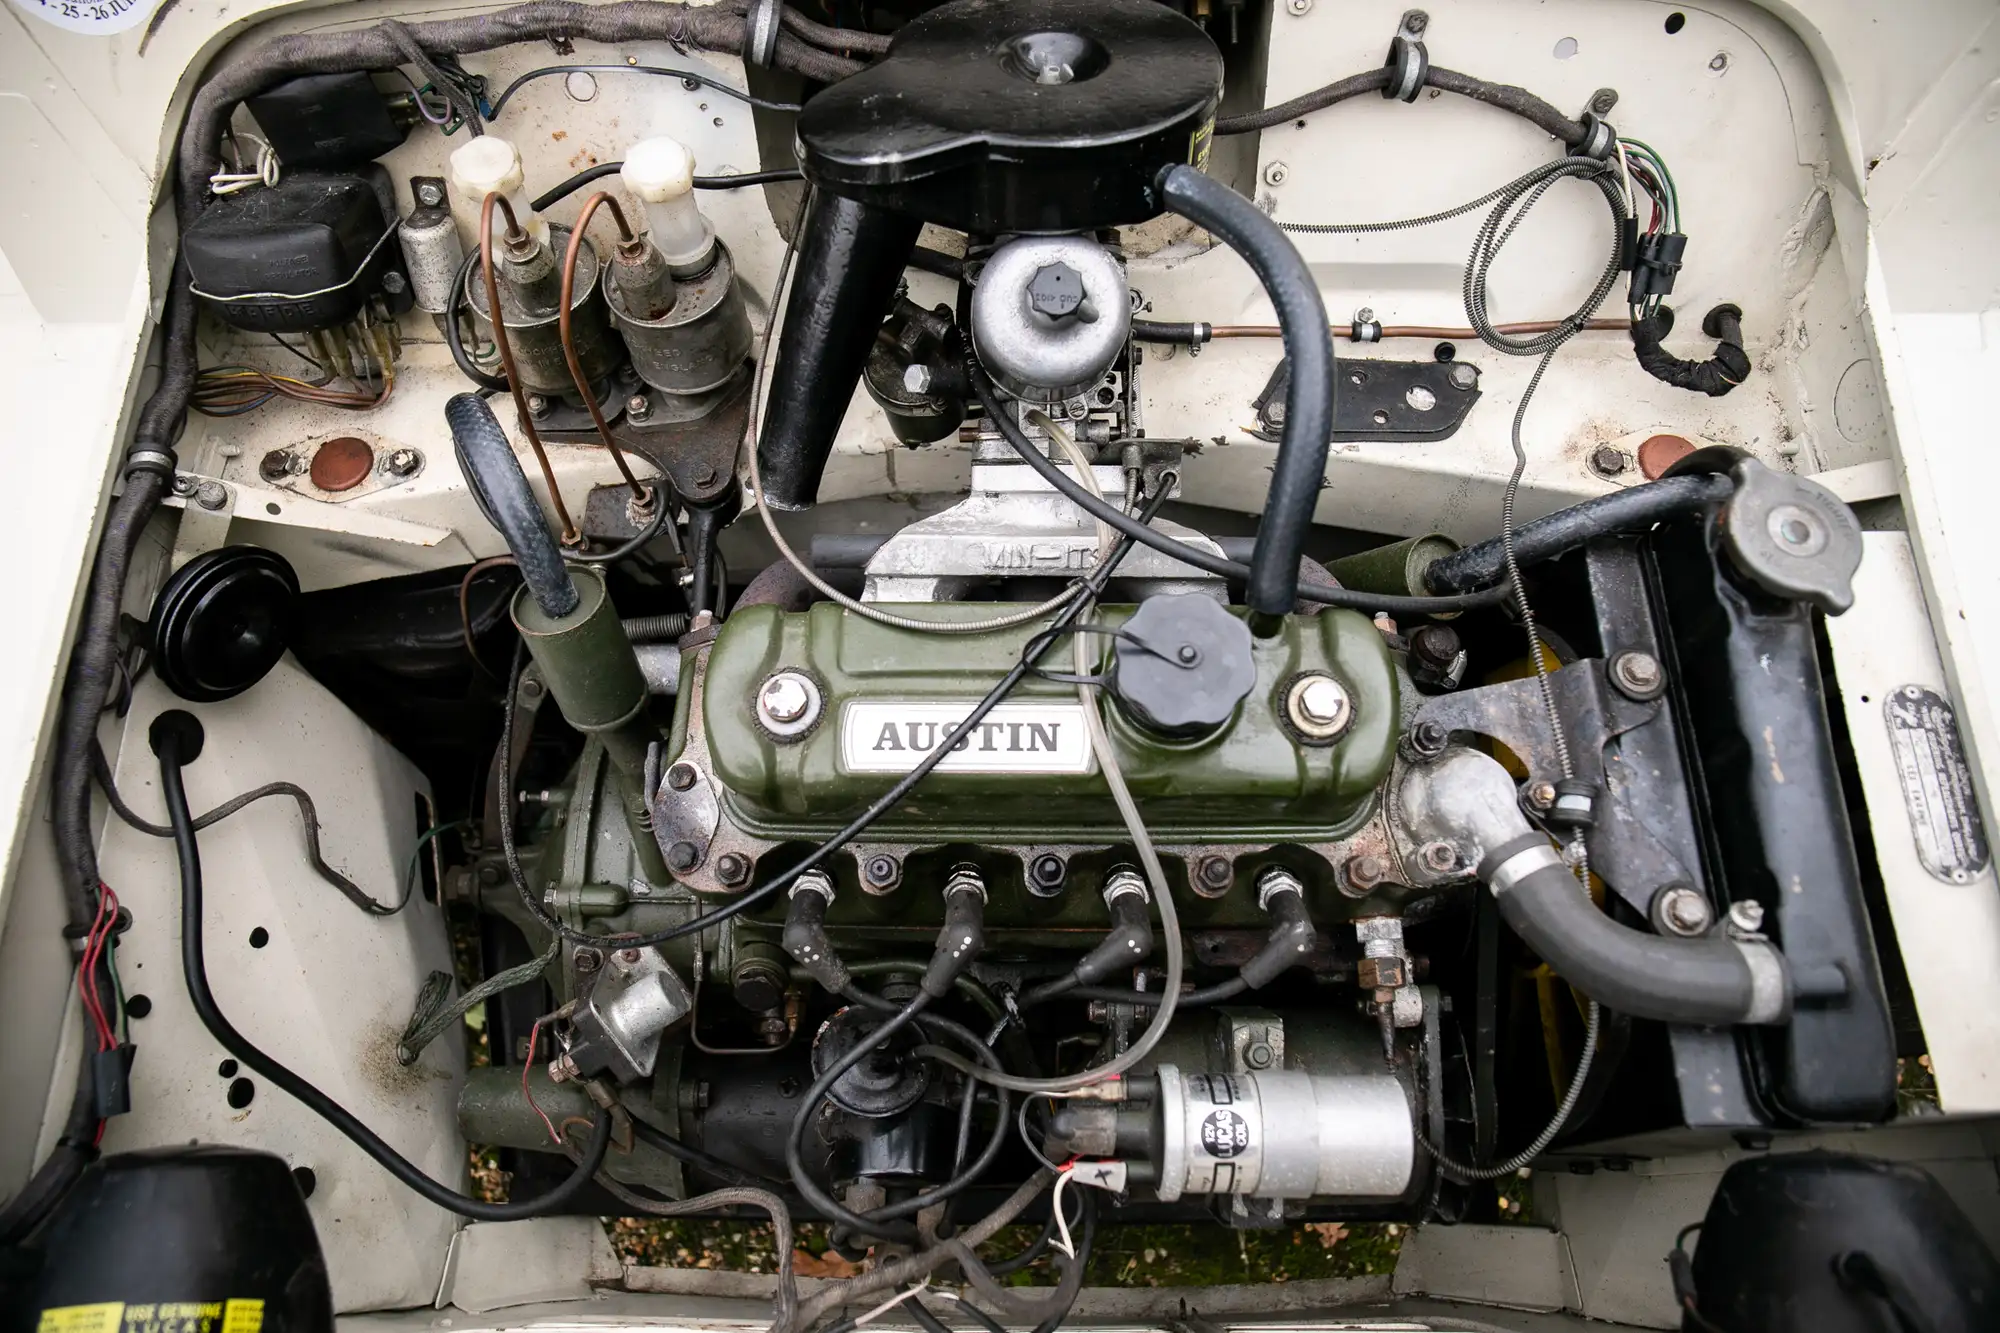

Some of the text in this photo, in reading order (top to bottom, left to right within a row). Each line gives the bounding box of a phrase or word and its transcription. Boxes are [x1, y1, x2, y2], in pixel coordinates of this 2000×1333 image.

[61, 3, 80, 19] 25
[90, 5, 110, 20] 26
[872, 721, 1061, 752] AUSTIN
[1204, 1122, 1216, 1143] 12V
[1215, 1109, 1234, 1158] LUCAS
[1235, 1120, 1247, 1147] COIL
